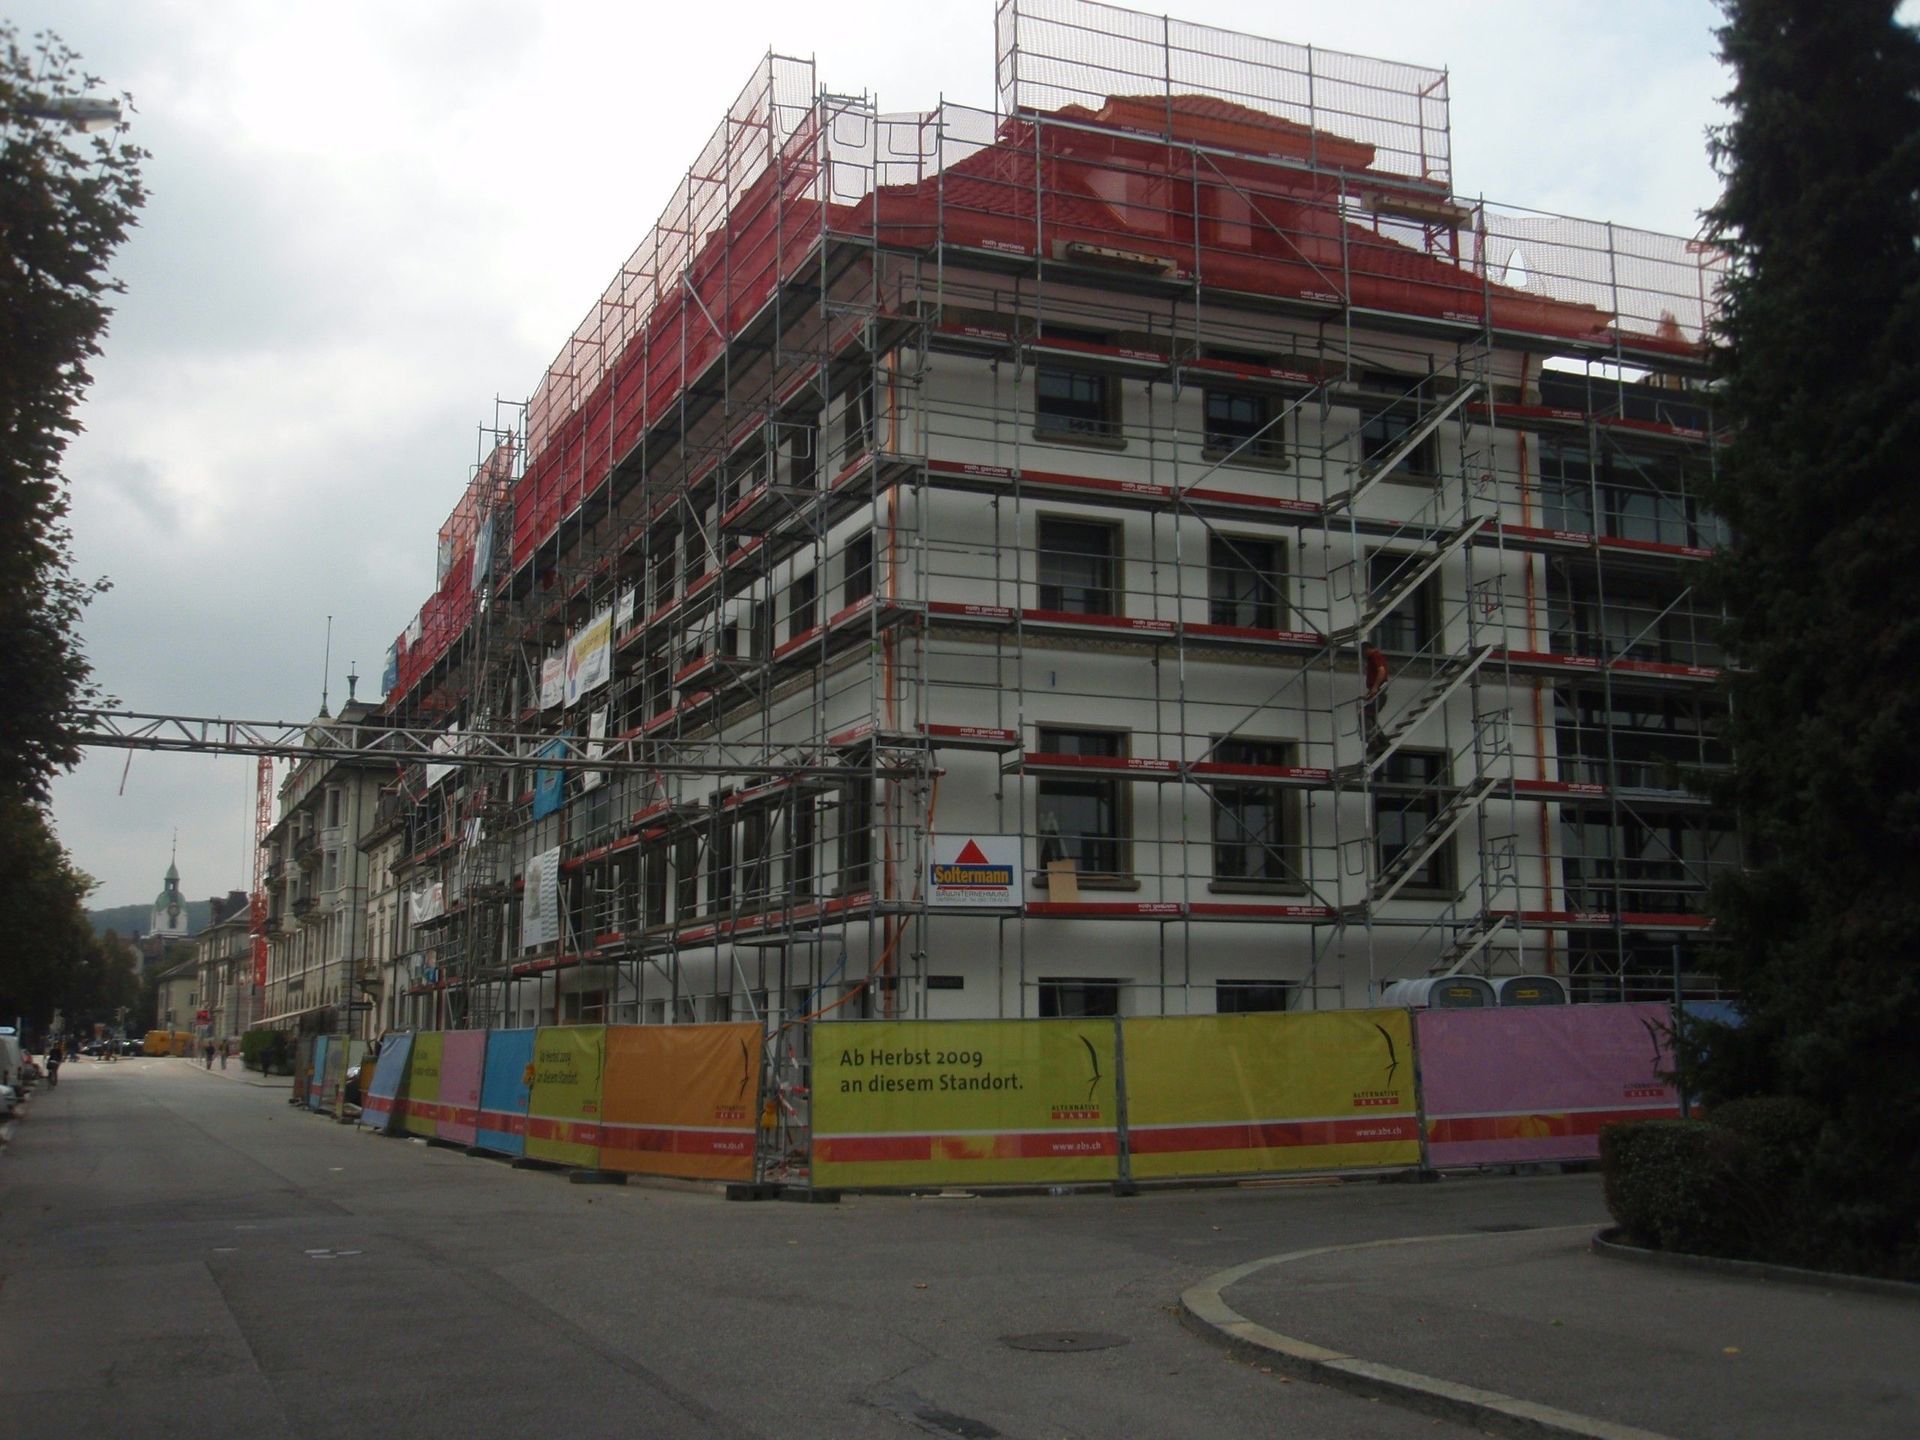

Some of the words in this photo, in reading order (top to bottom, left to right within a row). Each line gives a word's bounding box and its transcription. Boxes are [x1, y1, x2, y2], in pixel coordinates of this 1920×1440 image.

[934, 865, 1009, 884] Soltermann
[840, 1050, 864, 1066] Ab
[871, 1048, 931, 1066] Herbst
[936, 1051, 982, 1068] 2009
[840, 1079, 863, 1093] an
[868, 1074, 934, 1092] diesem
[939, 1072, 1024, 1092] Standort.
